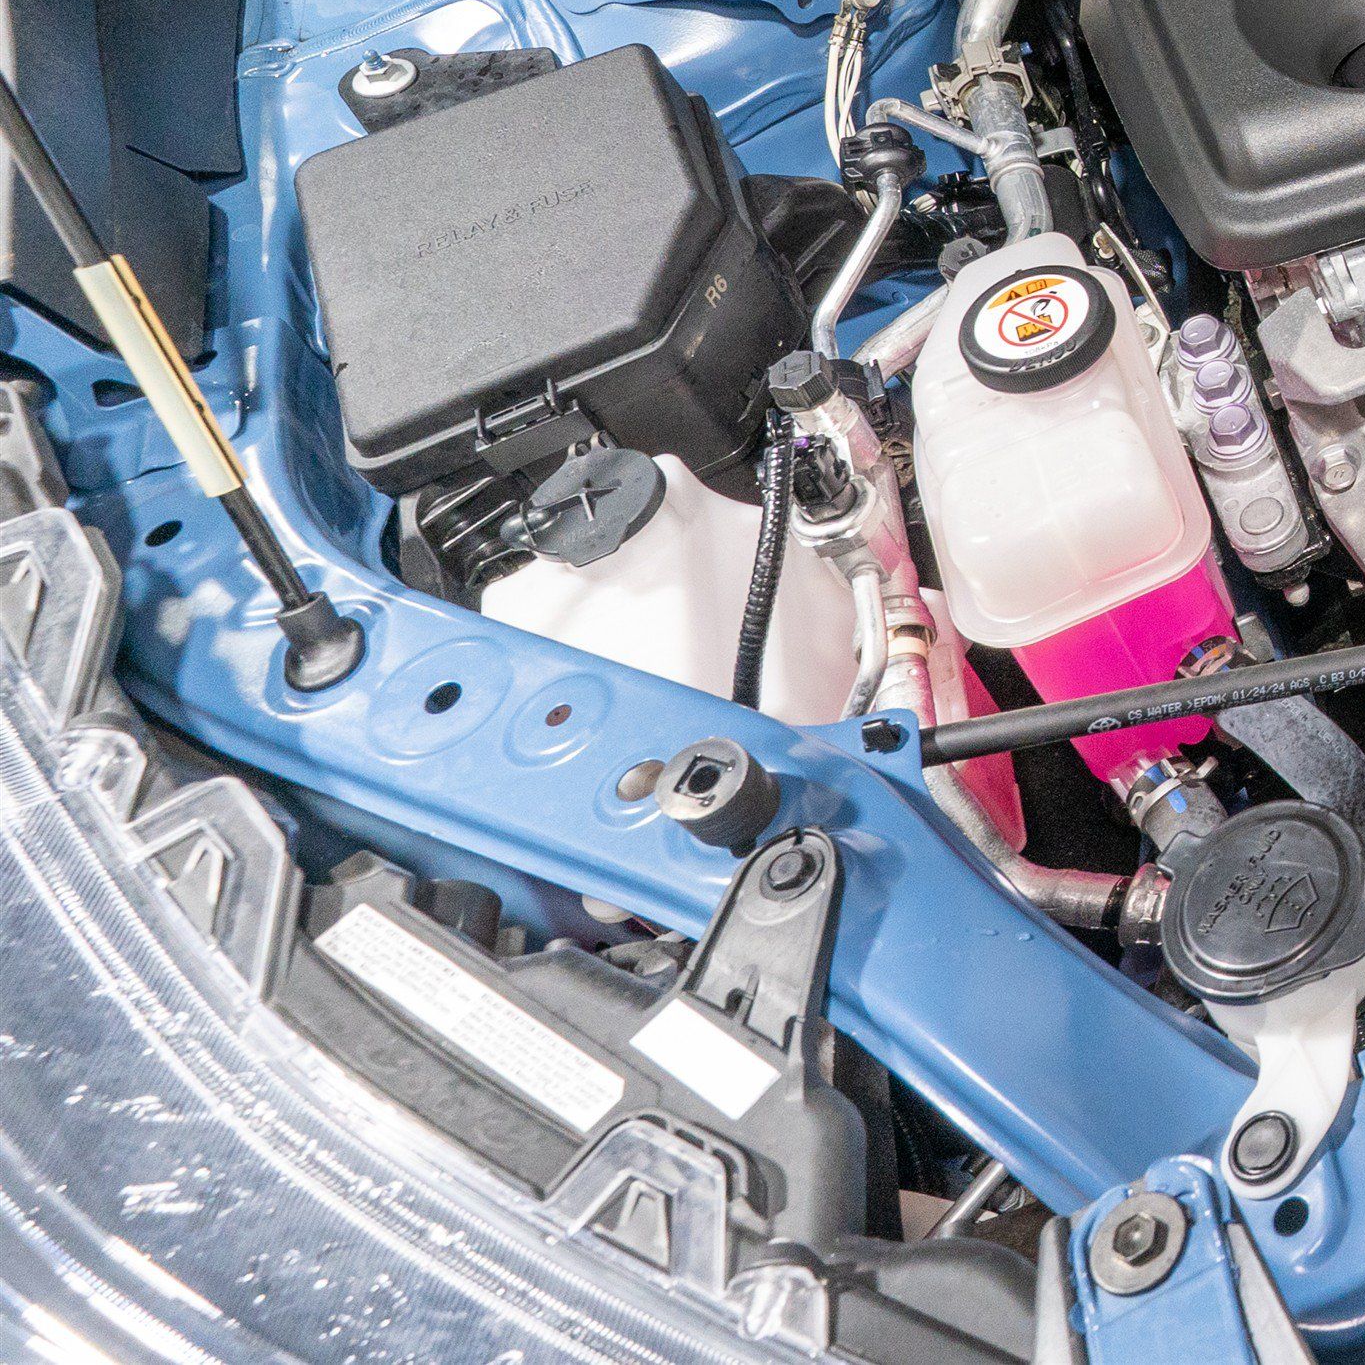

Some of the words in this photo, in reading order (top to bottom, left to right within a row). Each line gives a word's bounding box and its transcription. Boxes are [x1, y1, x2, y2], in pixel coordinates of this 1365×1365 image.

[416, 213, 498, 259] RELAY
[504, 206, 522, 225] &
[529, 180, 596, 215] FUSE
[704, 273, 728, 309] R6
[1127, 709, 1143, 720] CS
[1147, 701, 1183, 716] WATER
[1232, 682, 1286, 701] 01/24/24
[1319, 674, 1327, 685] C
[1198, 874, 1251, 934] WASHER
[1248, 830, 1281, 870] FLUID
